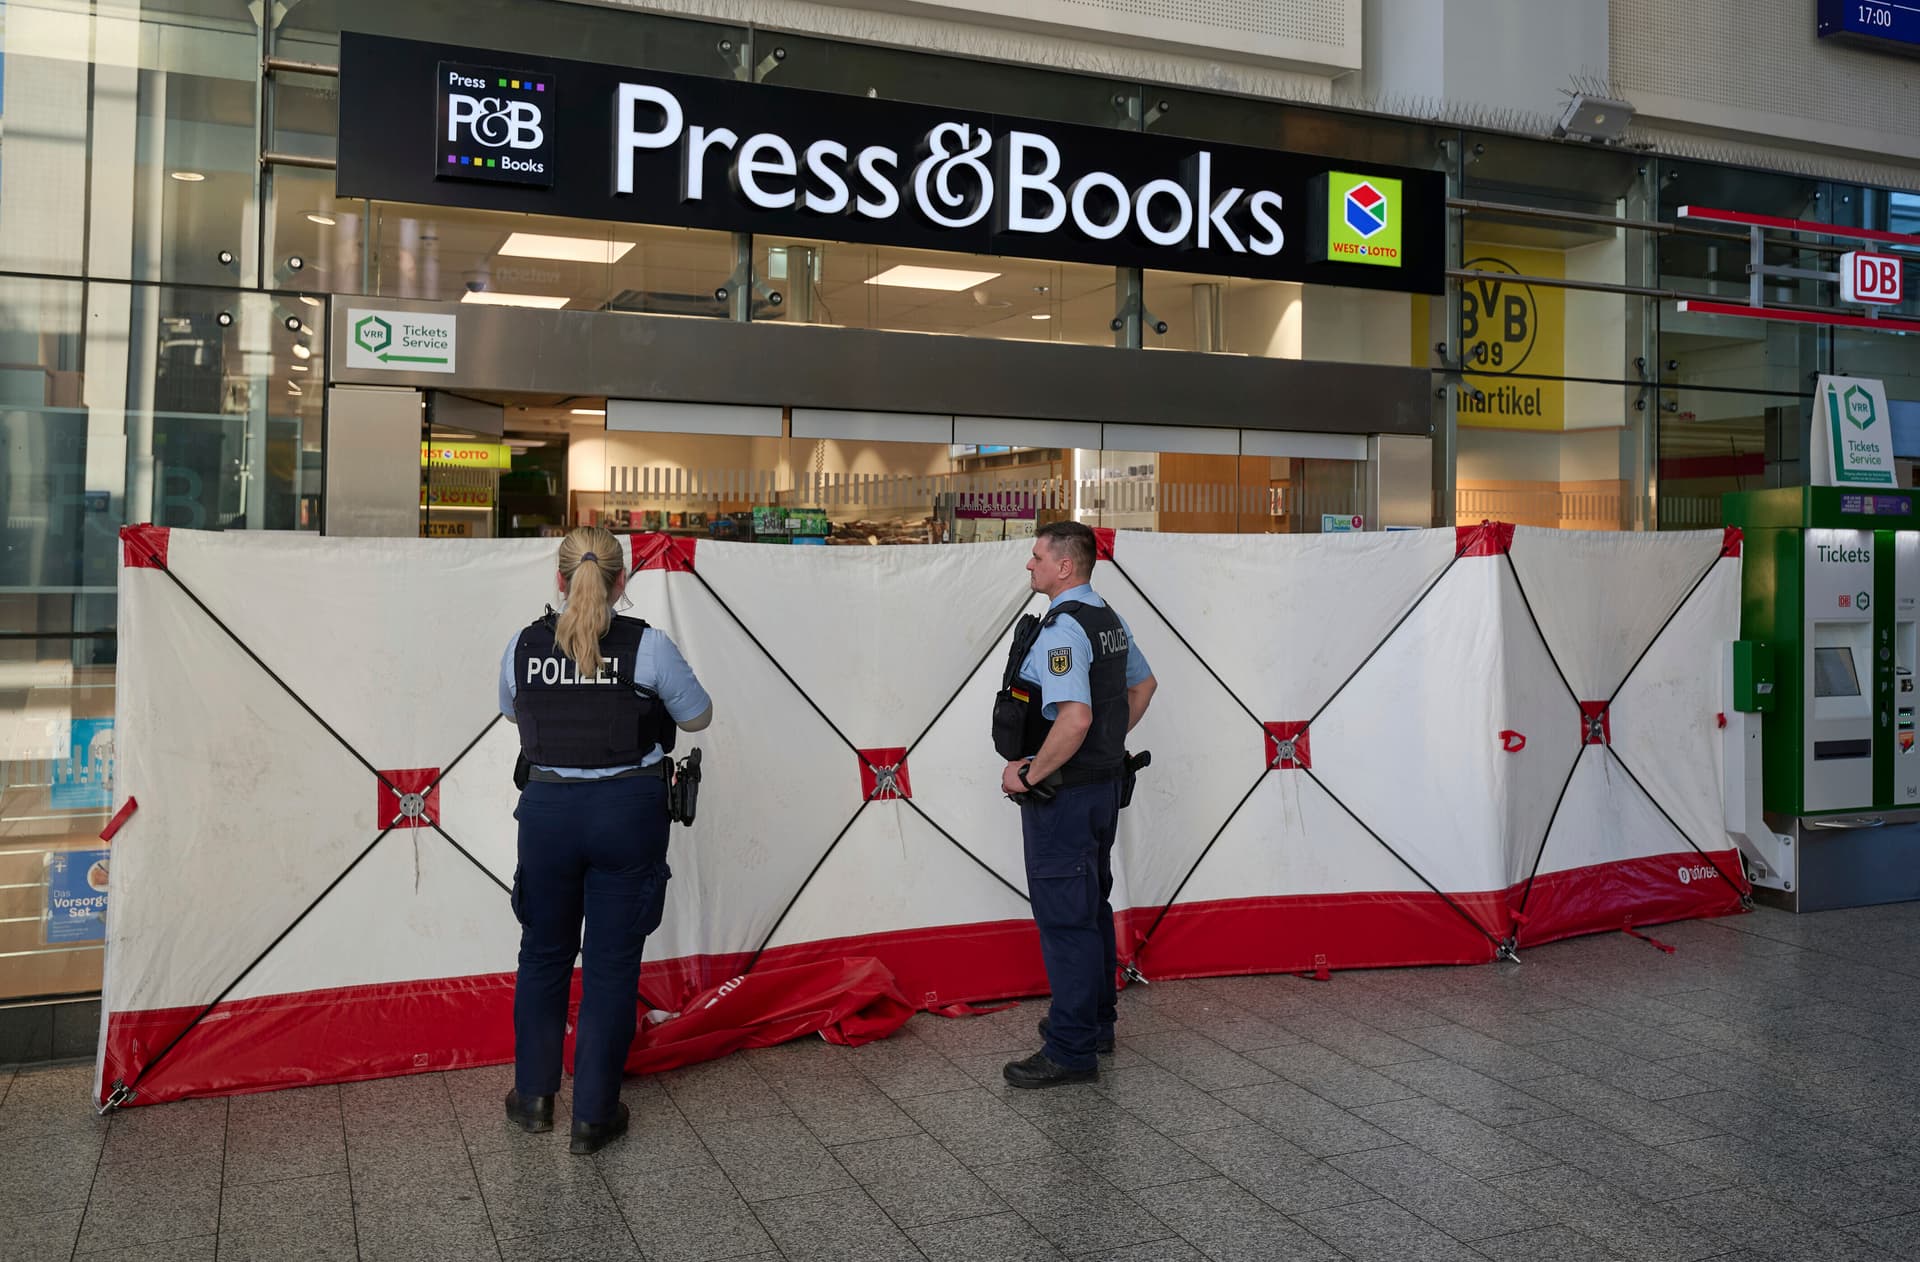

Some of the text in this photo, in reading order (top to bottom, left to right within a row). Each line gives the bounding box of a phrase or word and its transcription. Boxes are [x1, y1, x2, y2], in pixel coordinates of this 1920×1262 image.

[1859, 5, 1891, 27] 17:00
[448, 71, 486, 89] Press
[448, 93, 544, 150] P&B
[501, 155, 544, 173] Books
[1333, 242, 1397, 258] WEST LOTTO
[1860, 259, 1897, 295] DB
[363, 329, 384, 339] VRR
[403, 324, 448, 338] Tickets
[402, 337, 448, 349] Service
[1852, 401, 1868, 413] VRR
[1848, 440, 1880, 453] Tickets
[420, 448, 489, 460] EST LOTTO
[1849, 452, 1882, 465] Service
[441, 490, 488, 504] LOTTO
[1817, 544, 1870, 563] Tickets
[69, 907, 91, 918] Set
